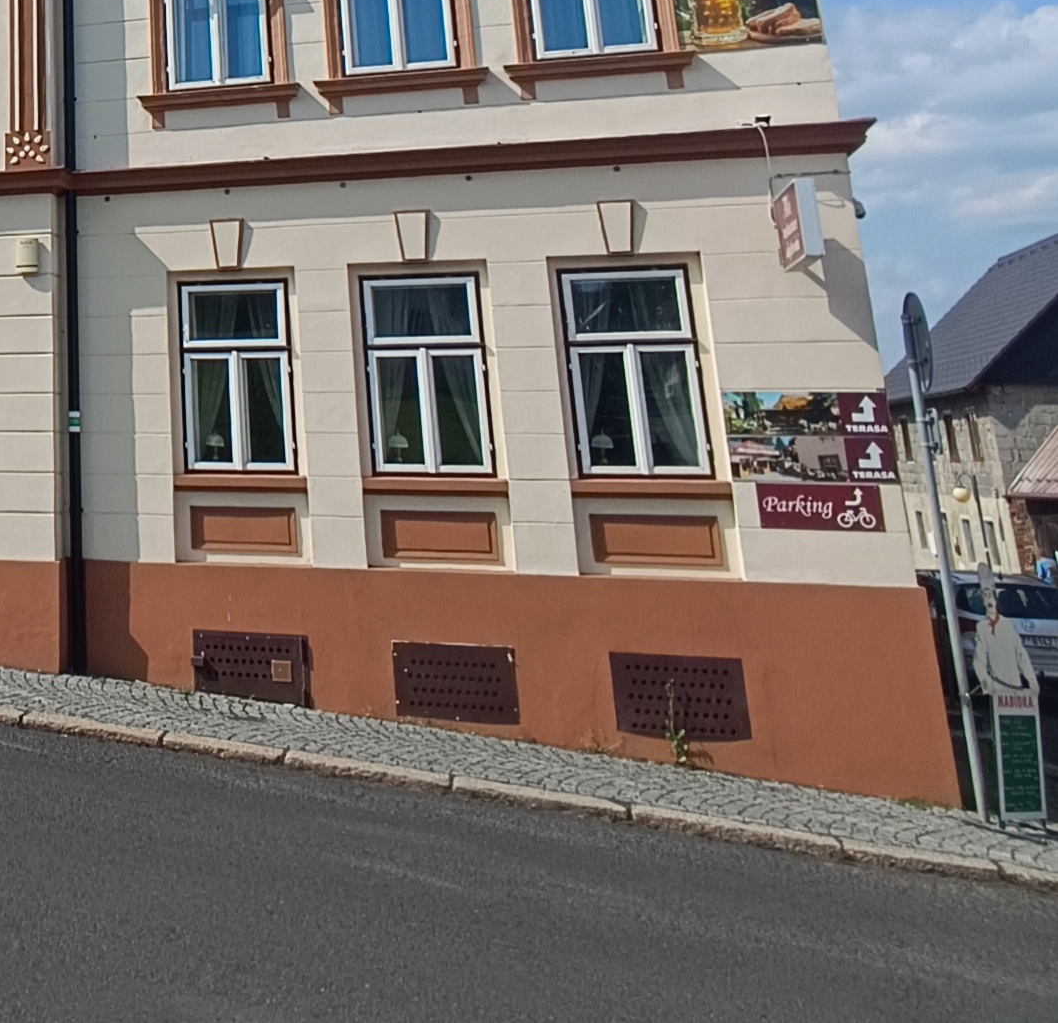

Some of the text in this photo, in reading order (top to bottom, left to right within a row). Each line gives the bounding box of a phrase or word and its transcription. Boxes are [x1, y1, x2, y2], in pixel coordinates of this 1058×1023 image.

[845, 424, 889, 433] TERASA
[852, 470, 896, 479] TERASA
[762, 494, 833, 519] Parking
